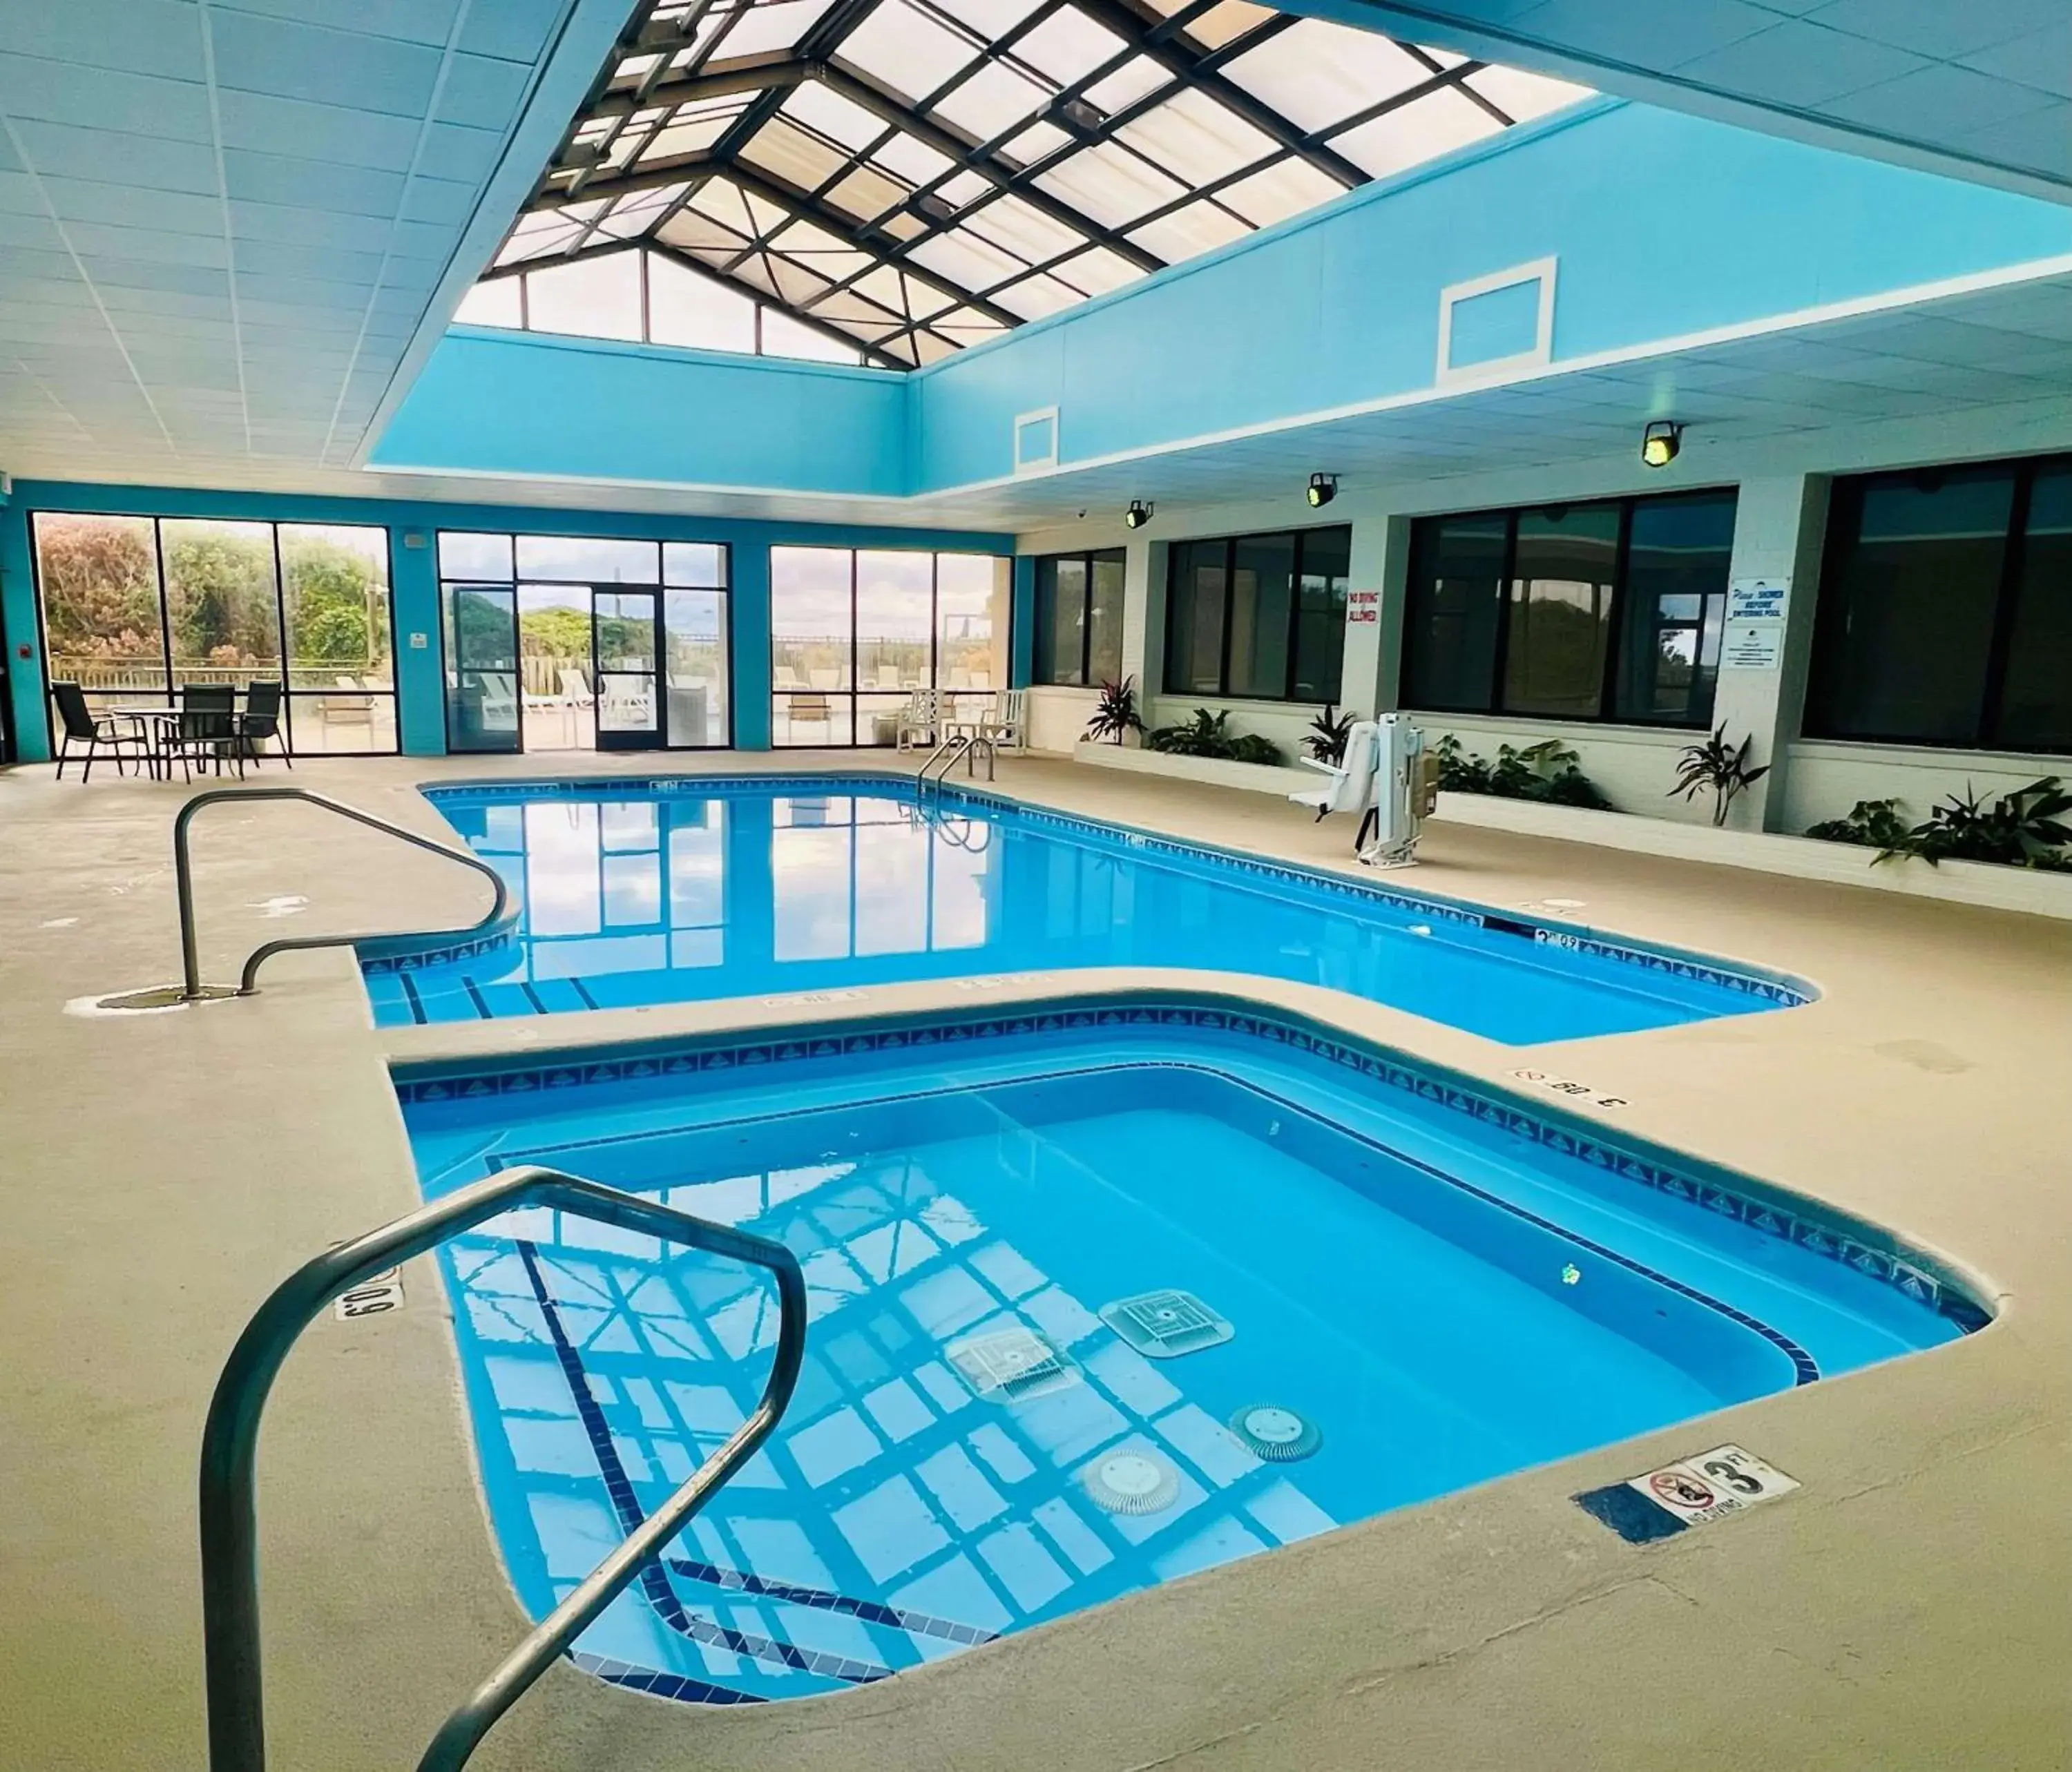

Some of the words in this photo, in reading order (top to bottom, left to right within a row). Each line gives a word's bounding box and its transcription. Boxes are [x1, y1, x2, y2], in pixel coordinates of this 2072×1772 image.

[1349, 593, 1357, 604] NO
[1359, 592, 1378, 604] DIVING
[1758, 590, 1783, 599] SHOWER
[1349, 610, 1376, 622] ALLOWED
[1704, 1461, 1763, 1494] 3
